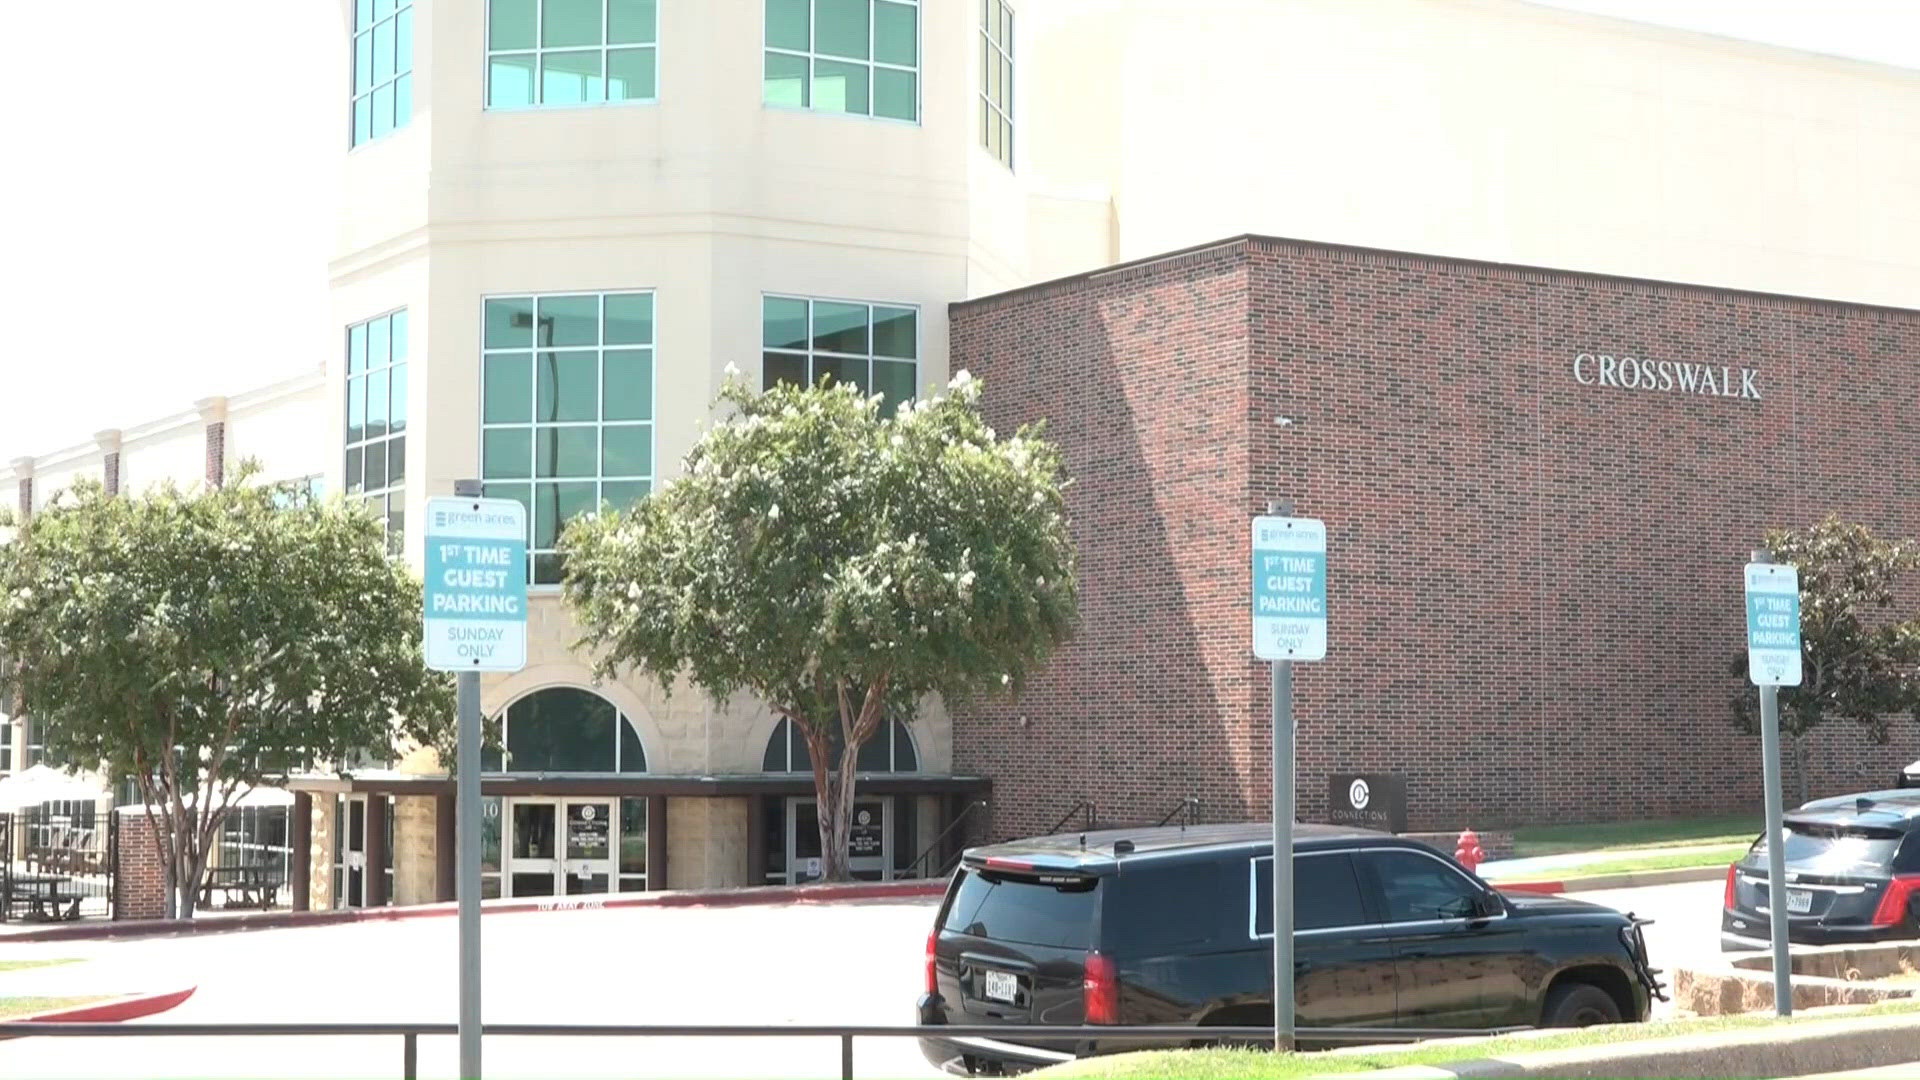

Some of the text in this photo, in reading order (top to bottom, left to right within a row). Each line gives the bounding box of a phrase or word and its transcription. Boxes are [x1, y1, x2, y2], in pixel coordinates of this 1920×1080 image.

[1573, 353, 1762, 399] CROSSWALK
[463, 545, 511, 565] TIME
[1281, 556, 1316, 573] TIME
[444, 568, 508, 588] GUEST
[1267, 576, 1312, 592] GUEST
[433, 593, 518, 613] PARKING
[1259, 595, 1320, 613] PARKING
[1767, 598, 1792, 612] TIME
[1757, 613, 1790, 628] GUEST
[448, 627, 504, 641] SUNDAY
[1271, 623, 1310, 635] SUNDAY
[1277, 637, 1303, 648] ONLY
[1752, 631, 1797, 645] PARKING
[457, 644, 494, 657] ONLY
[1332, 809, 1388, 820] CONNECTIONS
